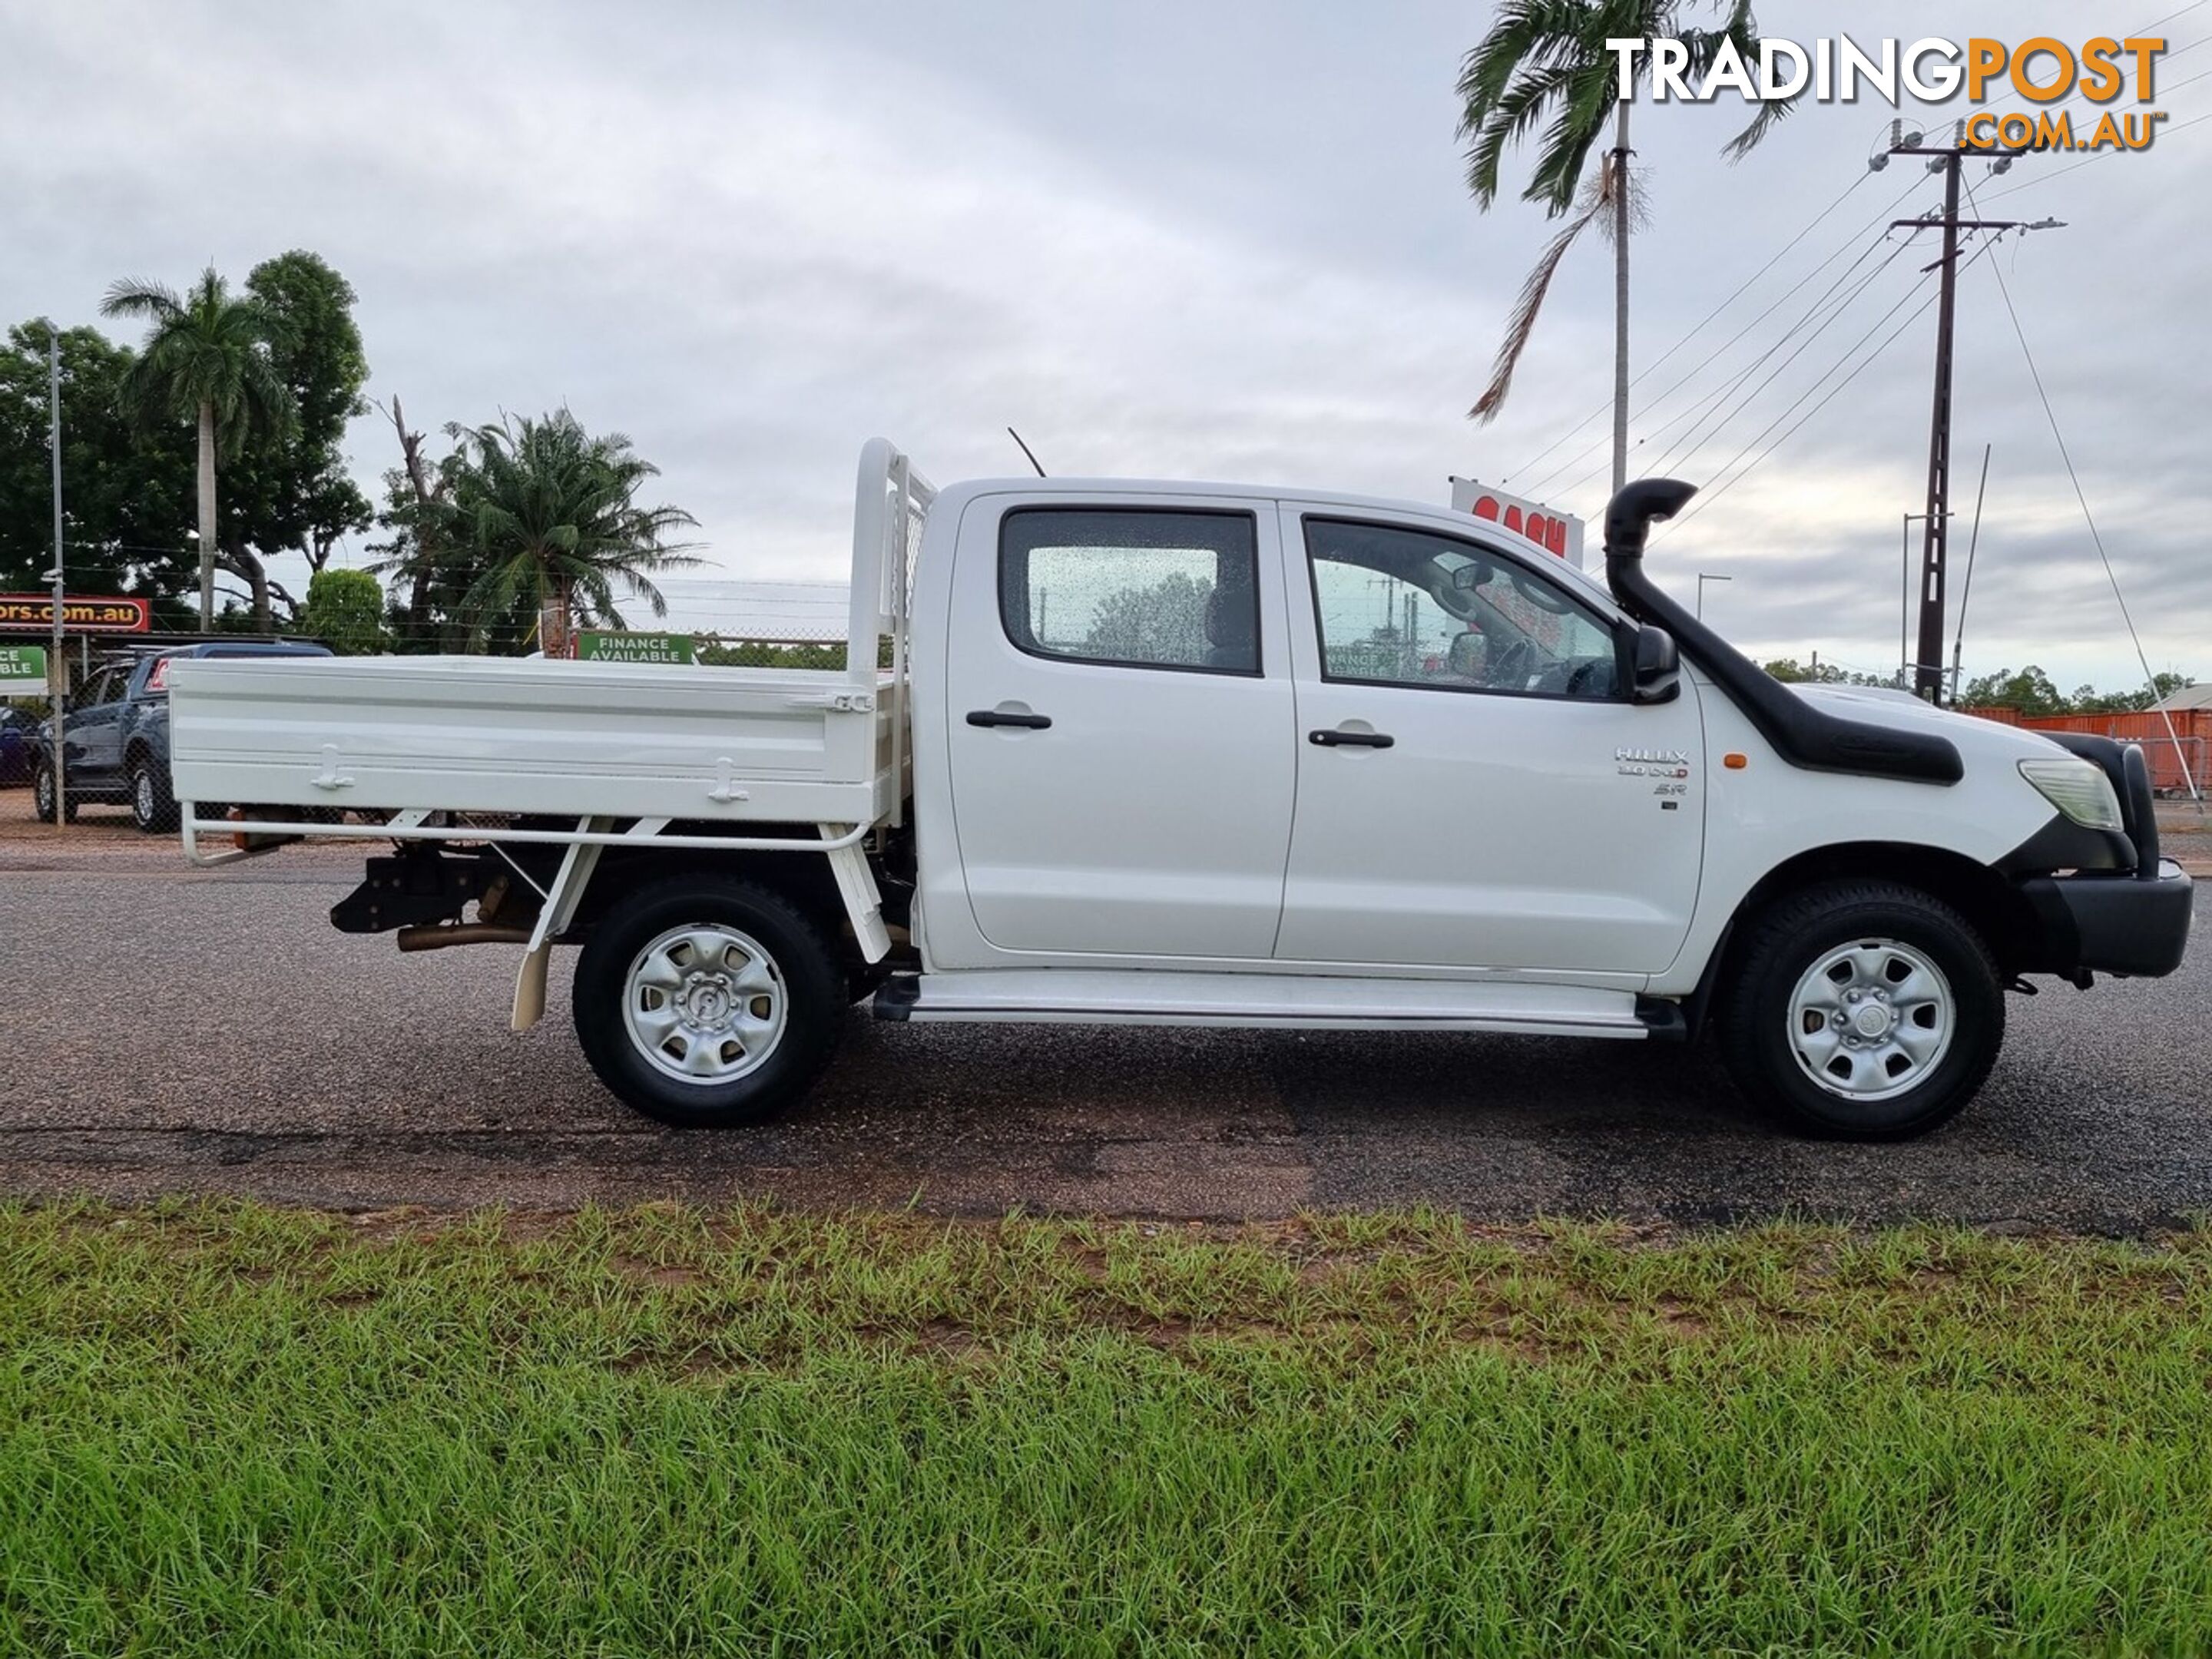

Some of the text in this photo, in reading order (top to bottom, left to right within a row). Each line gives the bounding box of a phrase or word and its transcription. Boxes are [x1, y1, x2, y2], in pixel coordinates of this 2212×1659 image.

[599, 637, 669, 649] FINANCE
[589, 650, 680, 661] AVAILABLE
[1615, 747, 1689, 765] HILUX
